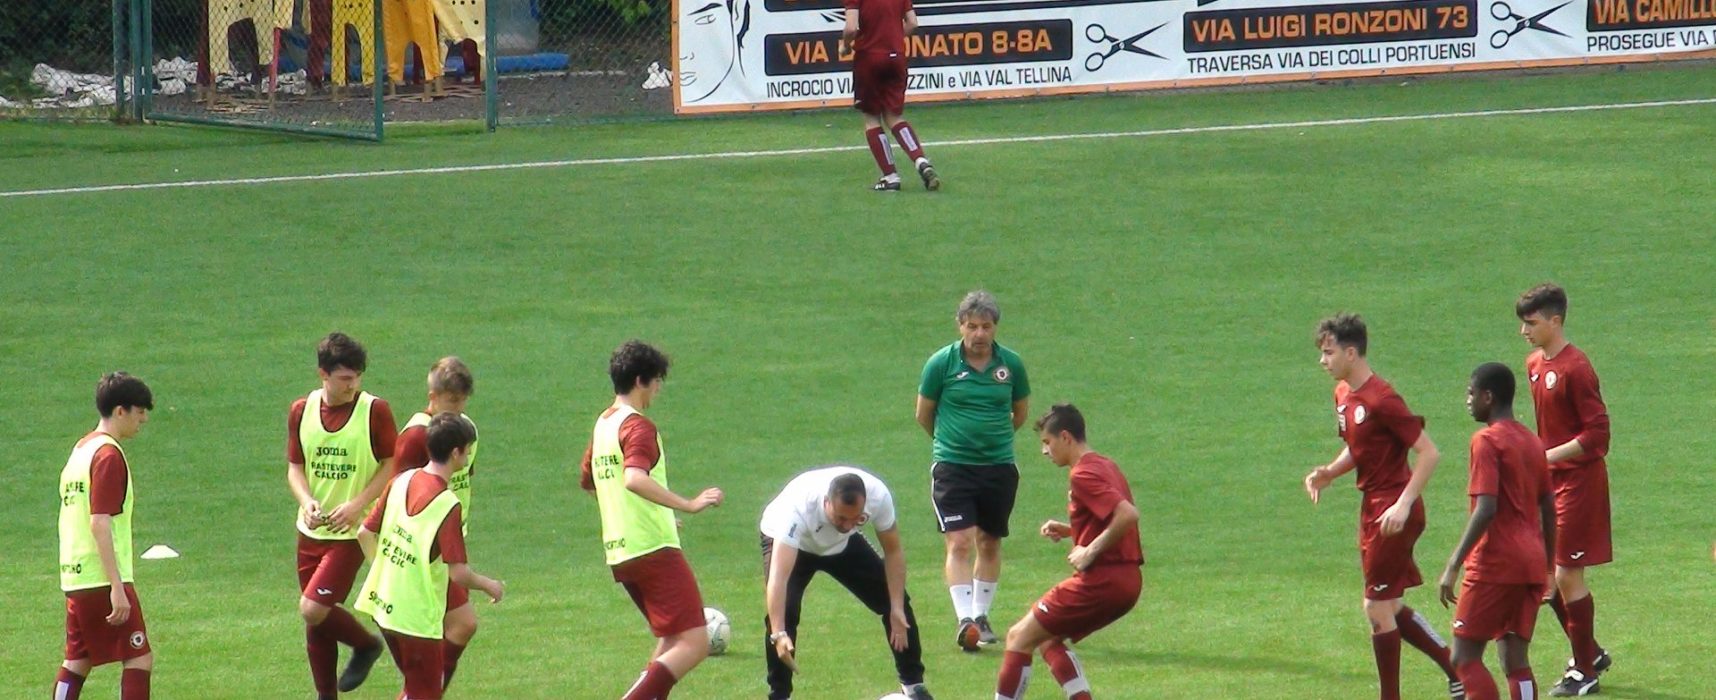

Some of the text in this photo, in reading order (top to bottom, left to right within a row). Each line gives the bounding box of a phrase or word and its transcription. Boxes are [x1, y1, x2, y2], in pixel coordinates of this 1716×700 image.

[1193, 5, 1468, 42] VIA LUIGI RONZONI 73
[1595, 0, 1629, 24] VIA
[785, 40, 829, 64] VIA
[992, 29, 1052, 54] 8-8A
[1587, 32, 1675, 52] PROSEGUE
[1680, 30, 1708, 46] VIA
[1187, 42, 1476, 73] TRAVERSA VIA DEI COLLI PORTUENSI
[767, 79, 833, 98] INCROCIO
[837, 78, 854, 94] VI
[948, 76, 956, 87] e
[959, 70, 982, 87] VIA
[985, 69, 1012, 85] VAL
[1016, 66, 1072, 83] TELLINA
